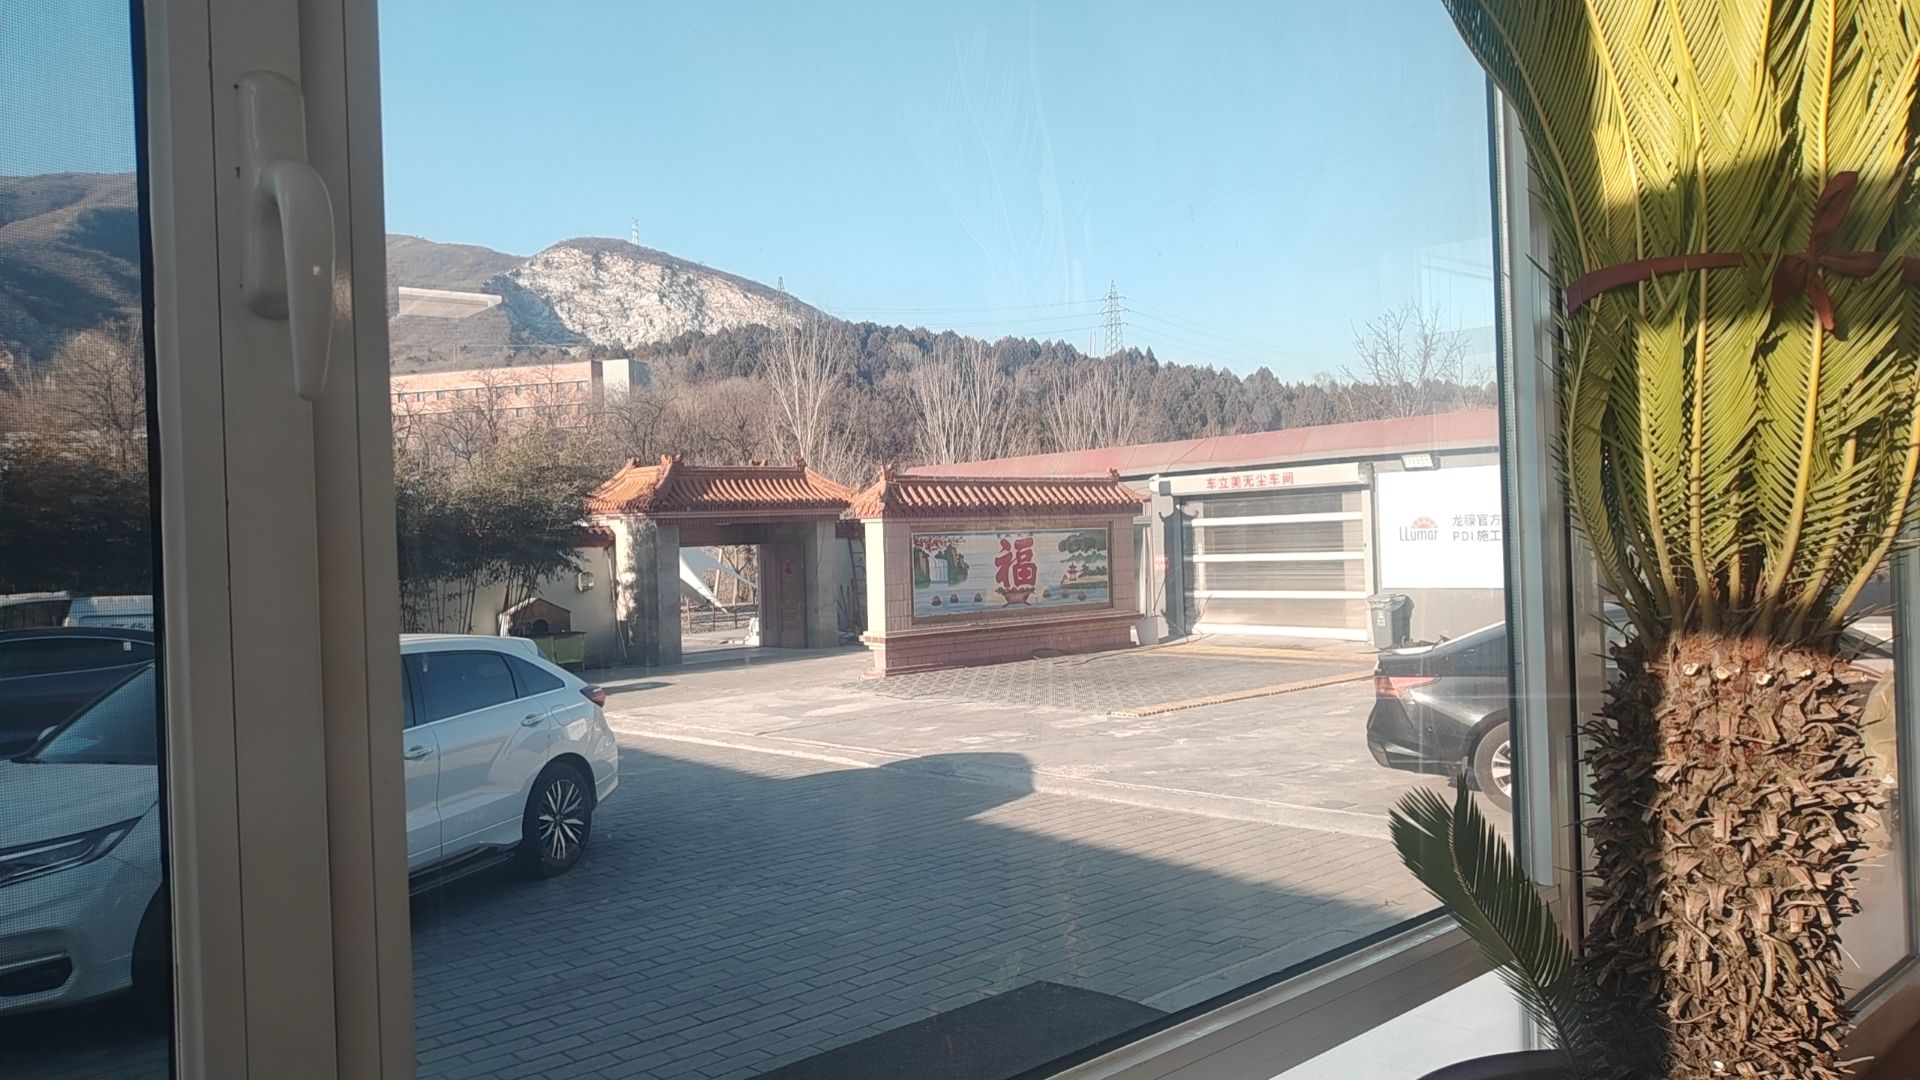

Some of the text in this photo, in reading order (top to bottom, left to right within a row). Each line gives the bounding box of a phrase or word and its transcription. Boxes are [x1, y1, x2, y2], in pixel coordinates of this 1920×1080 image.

[1206, 472, 1294, 489] 车立美无尘车间
[1452, 513, 1501, 527] 龙膜官方
[1399, 526, 1438, 541] LLumar
[994, 537, 1037, 588] 福
